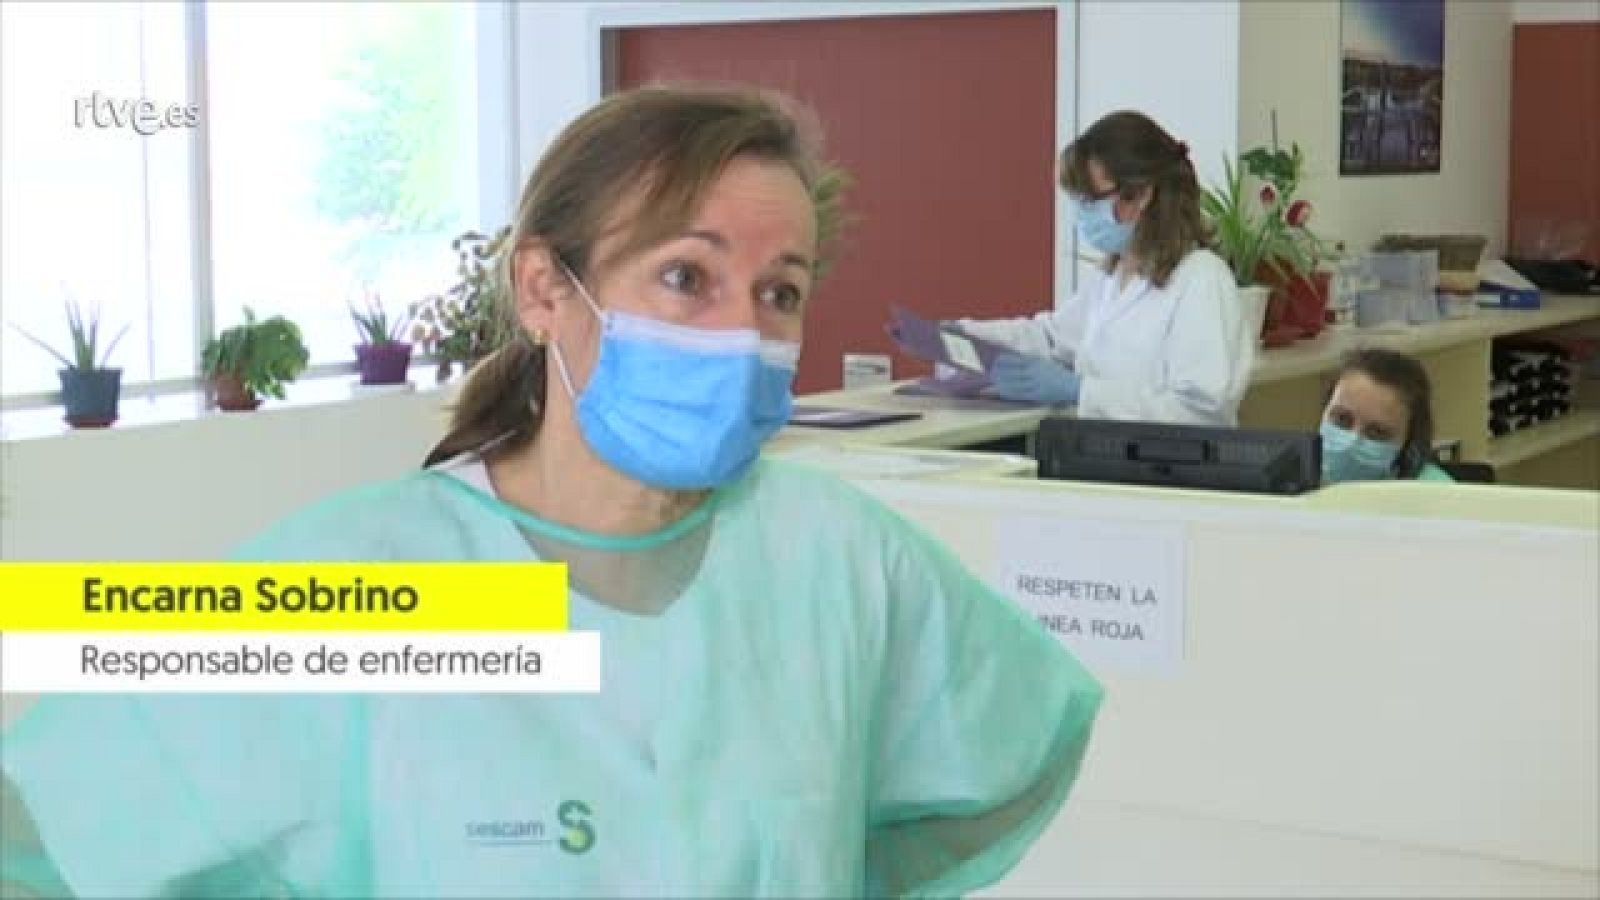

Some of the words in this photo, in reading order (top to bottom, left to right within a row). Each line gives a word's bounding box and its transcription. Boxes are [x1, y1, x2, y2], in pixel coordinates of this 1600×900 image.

[1016, 575, 1121, 601] RESPETEN
[1131, 586, 1158, 606] LA
[1091, 619, 1145, 641] ROJA
